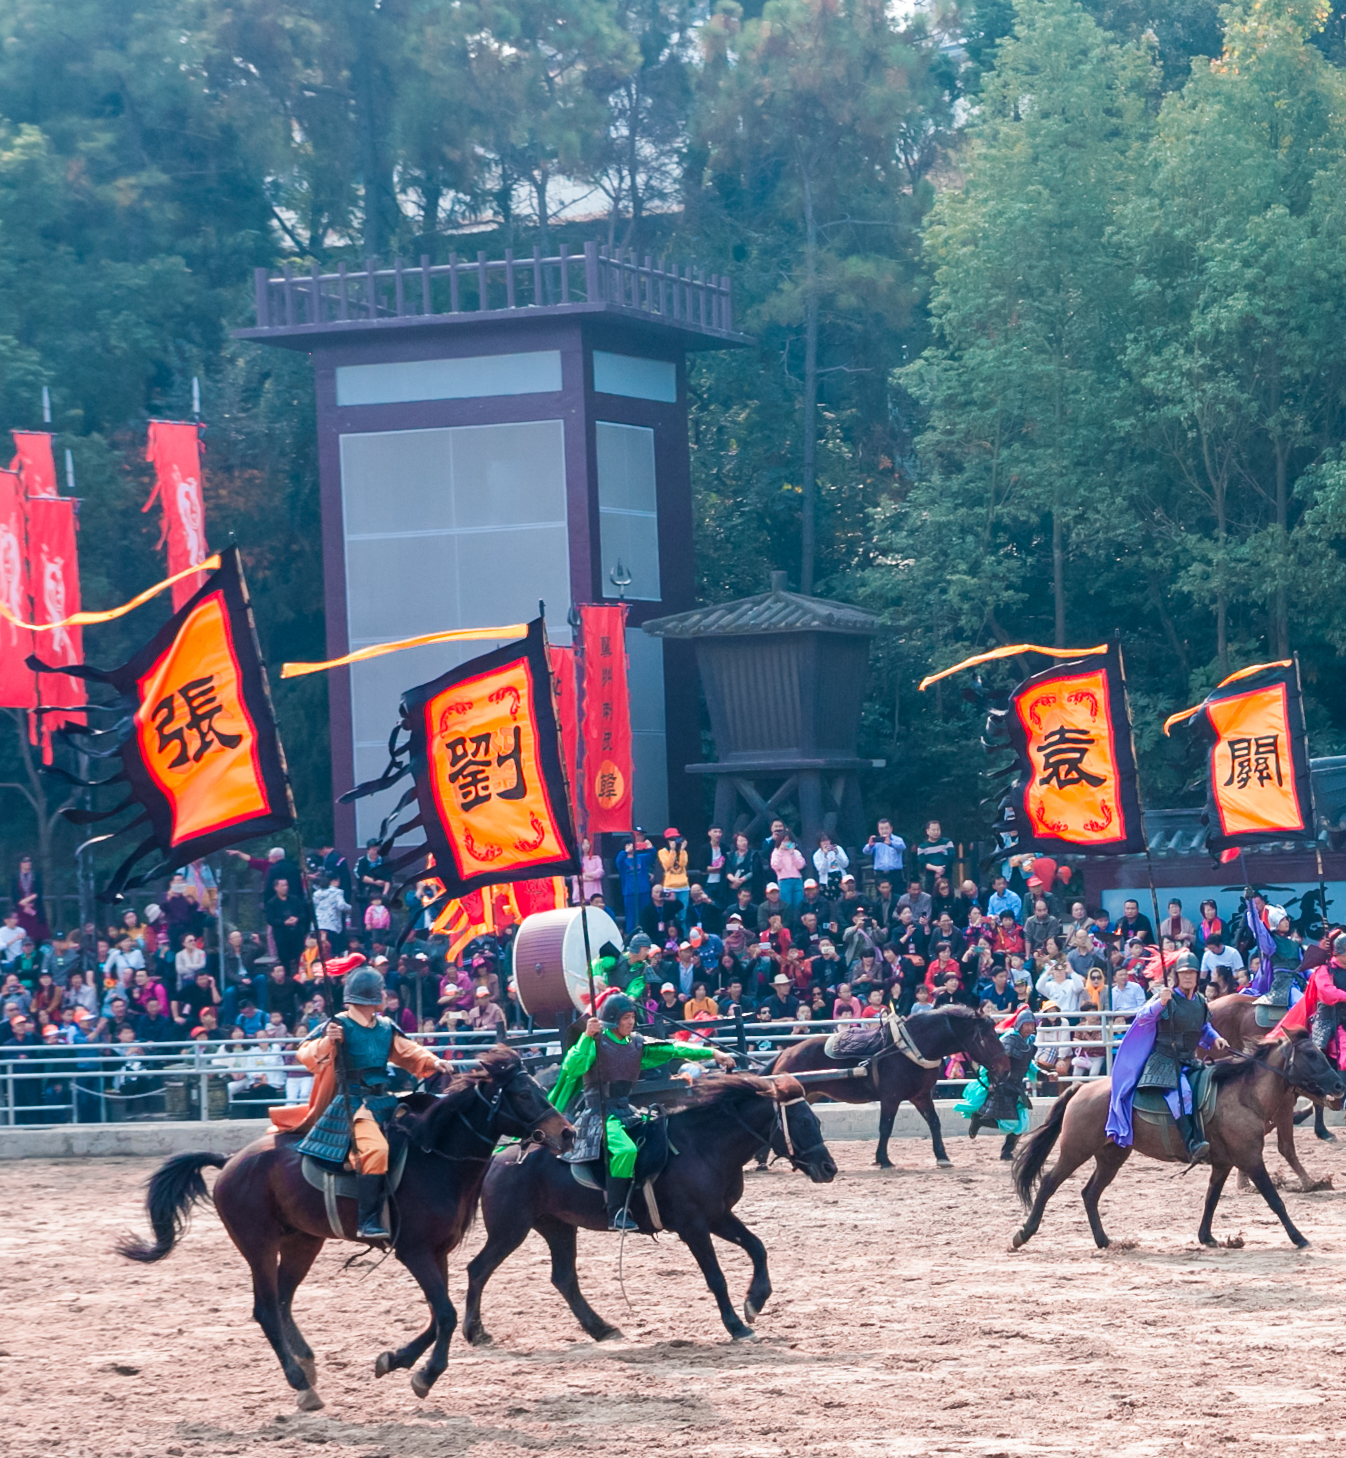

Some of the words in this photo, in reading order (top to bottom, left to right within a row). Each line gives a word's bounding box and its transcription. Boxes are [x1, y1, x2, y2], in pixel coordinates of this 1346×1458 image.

[151, 675, 243, 769] 張
[1037, 726, 1107, 790] 袁
[445, 725, 527, 812] 劉
[1223, 734, 1283, 790] 關
